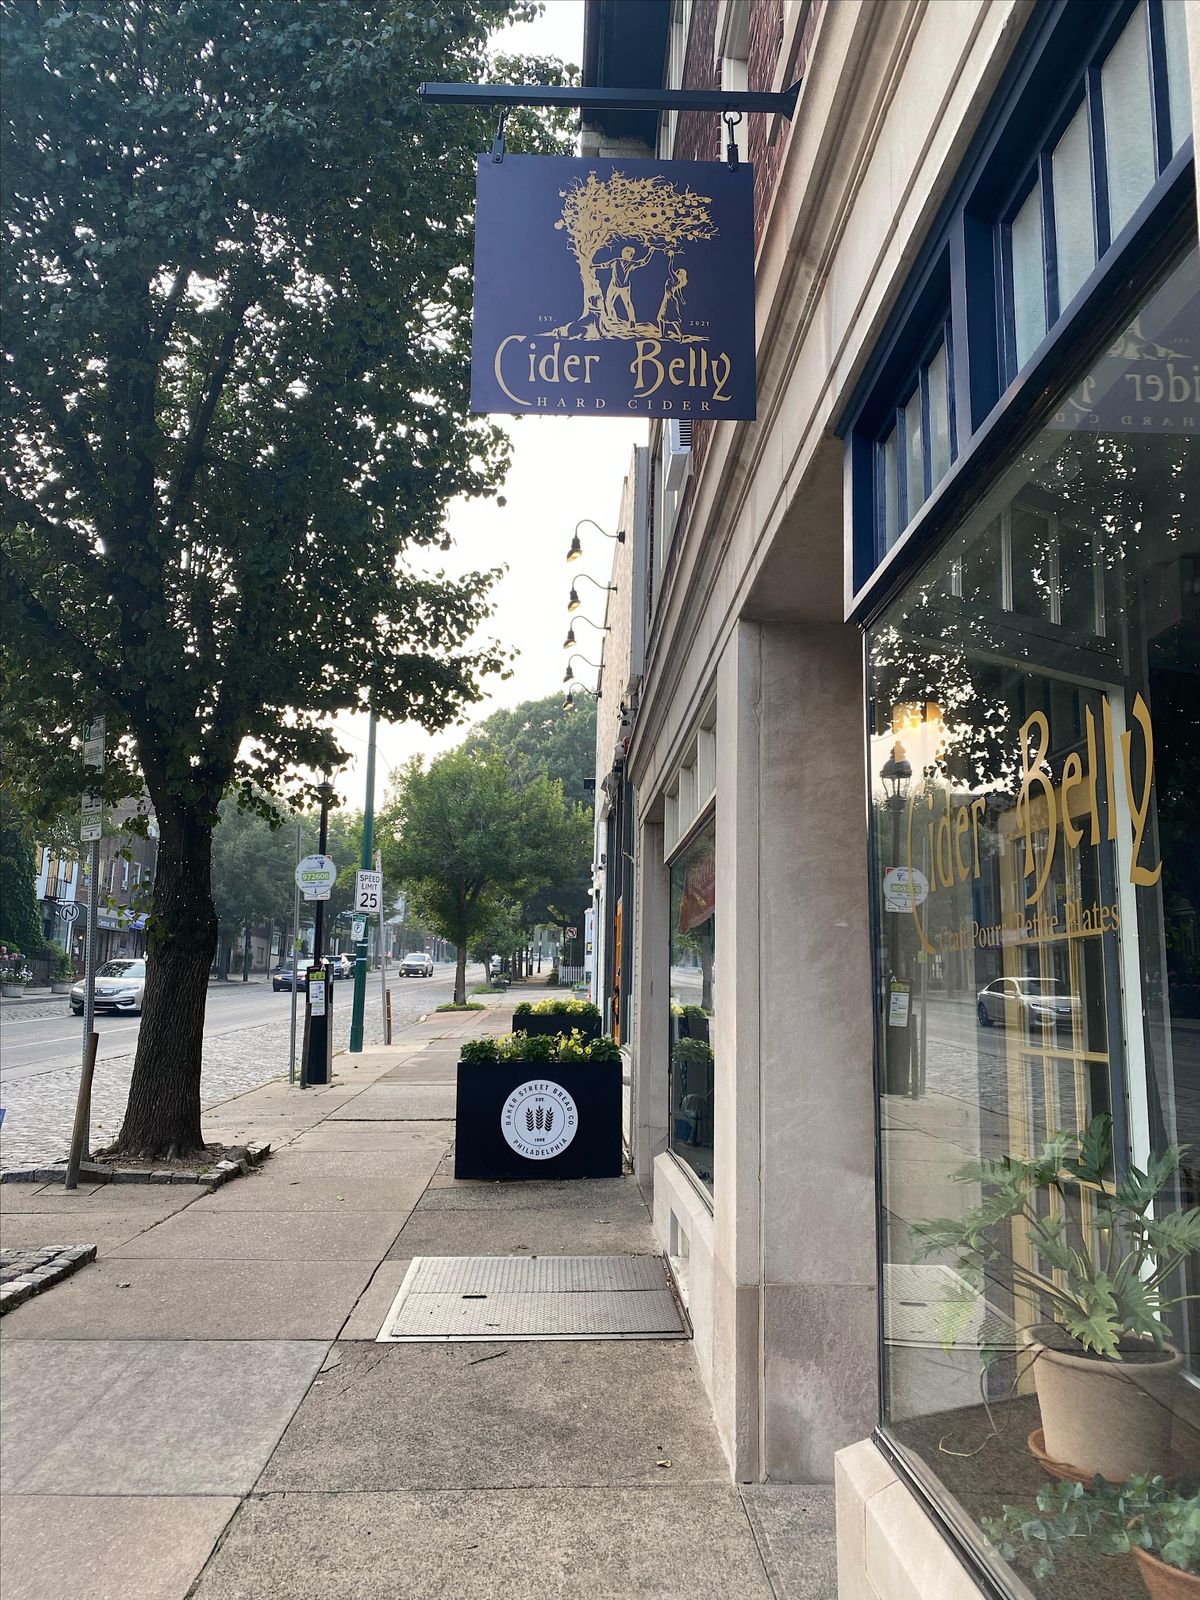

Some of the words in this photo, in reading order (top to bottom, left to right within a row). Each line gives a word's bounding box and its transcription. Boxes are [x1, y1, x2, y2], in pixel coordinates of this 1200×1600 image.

[494, 334, 601, 406] Cider
[629, 339, 733, 402] Belly
[536, 396, 606, 409] HARD
[627, 399, 711, 411] CIDER
[907, 775, 987, 954] Cider
[1016, 691, 1163, 905] Belly
[302, 872, 330, 881] 972606
[359, 874, 381, 883] SPEED
[361, 883, 378, 891] LIMIT
[360, 892, 378, 908] 25
[1015, 910, 1059, 938] Petite
[1063, 898, 1120, 932] Plates
[505, 1097, 518, 1126] BAKER
[518, 1084, 549, 1097] STREET
[552, 1087, 573, 1112] BREAD
[567, 1115, 575, 1128] CO.
[513, 1138, 567, 1156] PHILADELPHIA
